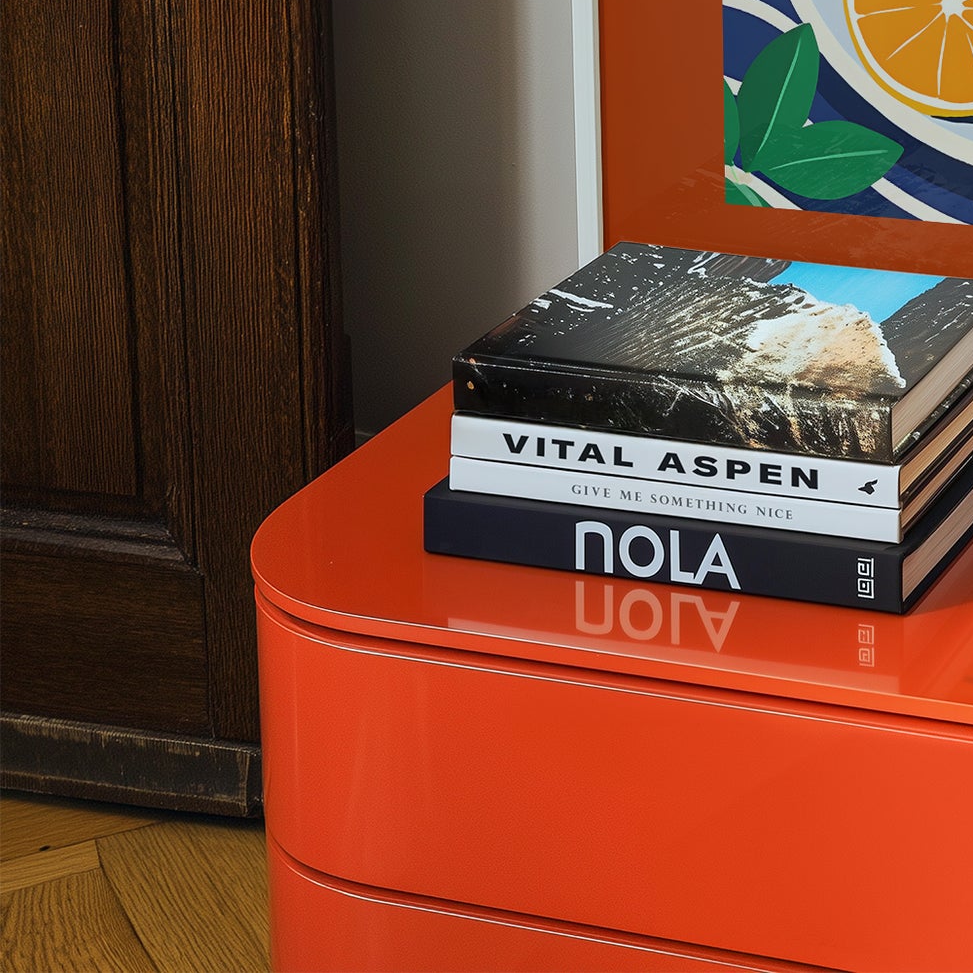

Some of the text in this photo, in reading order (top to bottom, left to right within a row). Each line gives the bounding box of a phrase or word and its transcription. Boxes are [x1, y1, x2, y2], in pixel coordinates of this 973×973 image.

[503, 433, 819, 490] VITAL ASPEN
[571, 484, 793, 520] GIVE ME SOMETHING NICE
